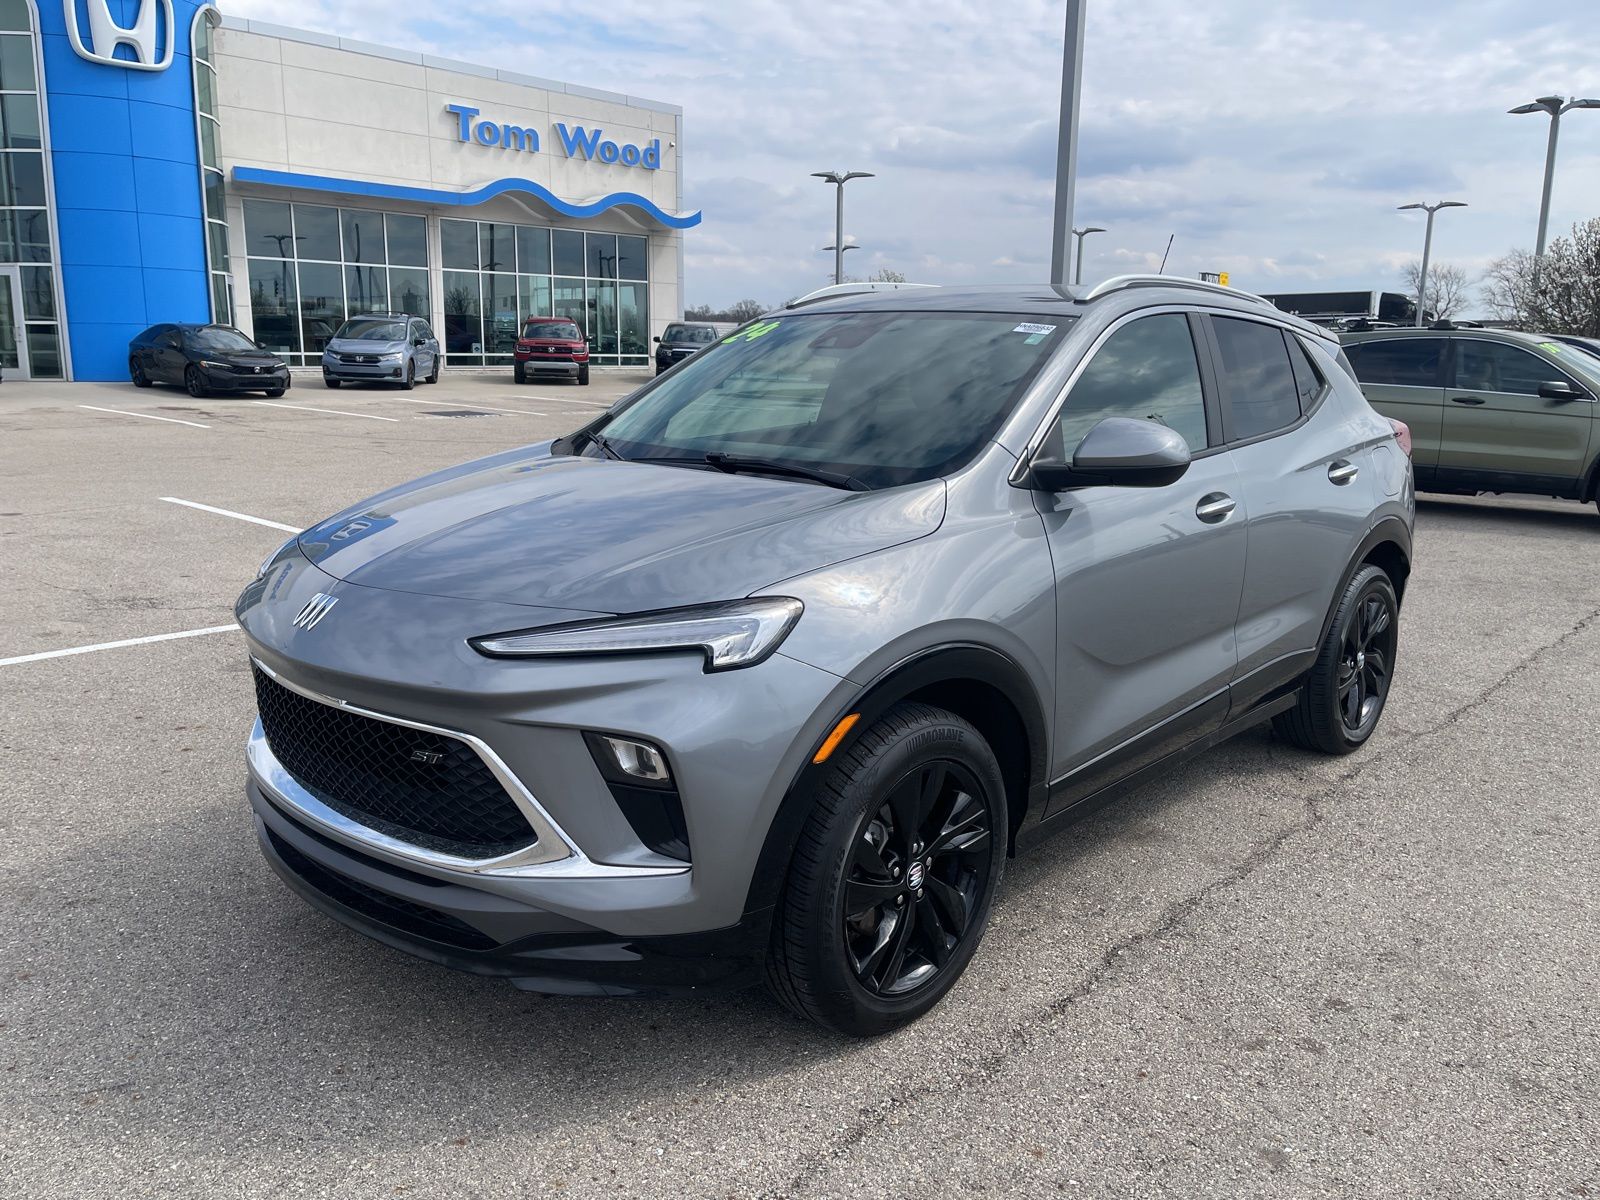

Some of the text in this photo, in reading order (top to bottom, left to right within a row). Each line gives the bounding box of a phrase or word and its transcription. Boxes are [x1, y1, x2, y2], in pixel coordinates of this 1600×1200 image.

[446, 104, 661, 170] Tom Wood
[410, 750, 444, 764] ST
